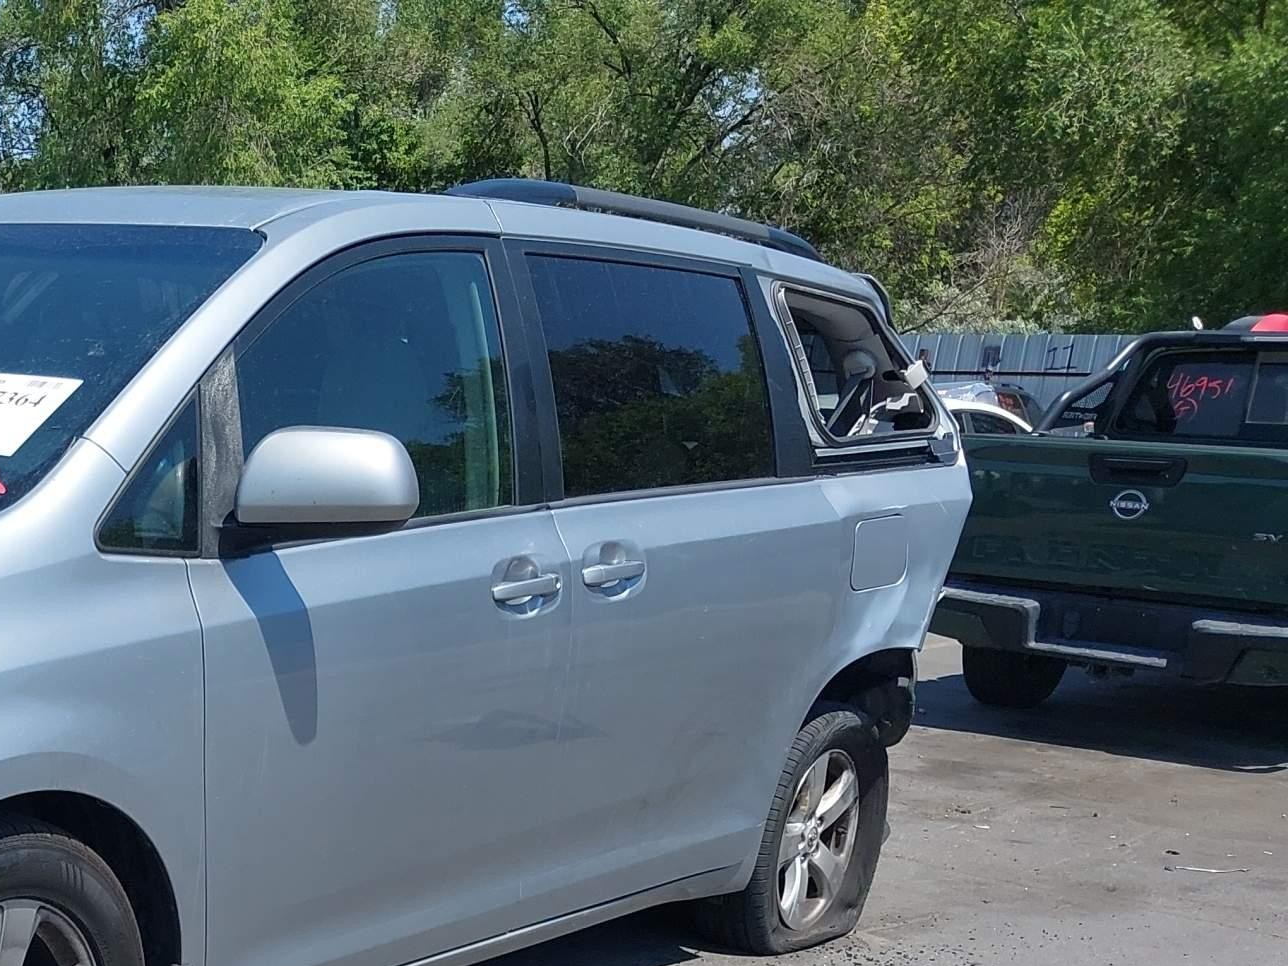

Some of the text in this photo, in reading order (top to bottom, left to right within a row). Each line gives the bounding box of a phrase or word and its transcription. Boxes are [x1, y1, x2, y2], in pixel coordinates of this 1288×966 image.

[1166, 372, 1234, 400] 46951
[1110, 500, 1149, 511] NISSAN
[1253, 532, 1283, 543] SV
